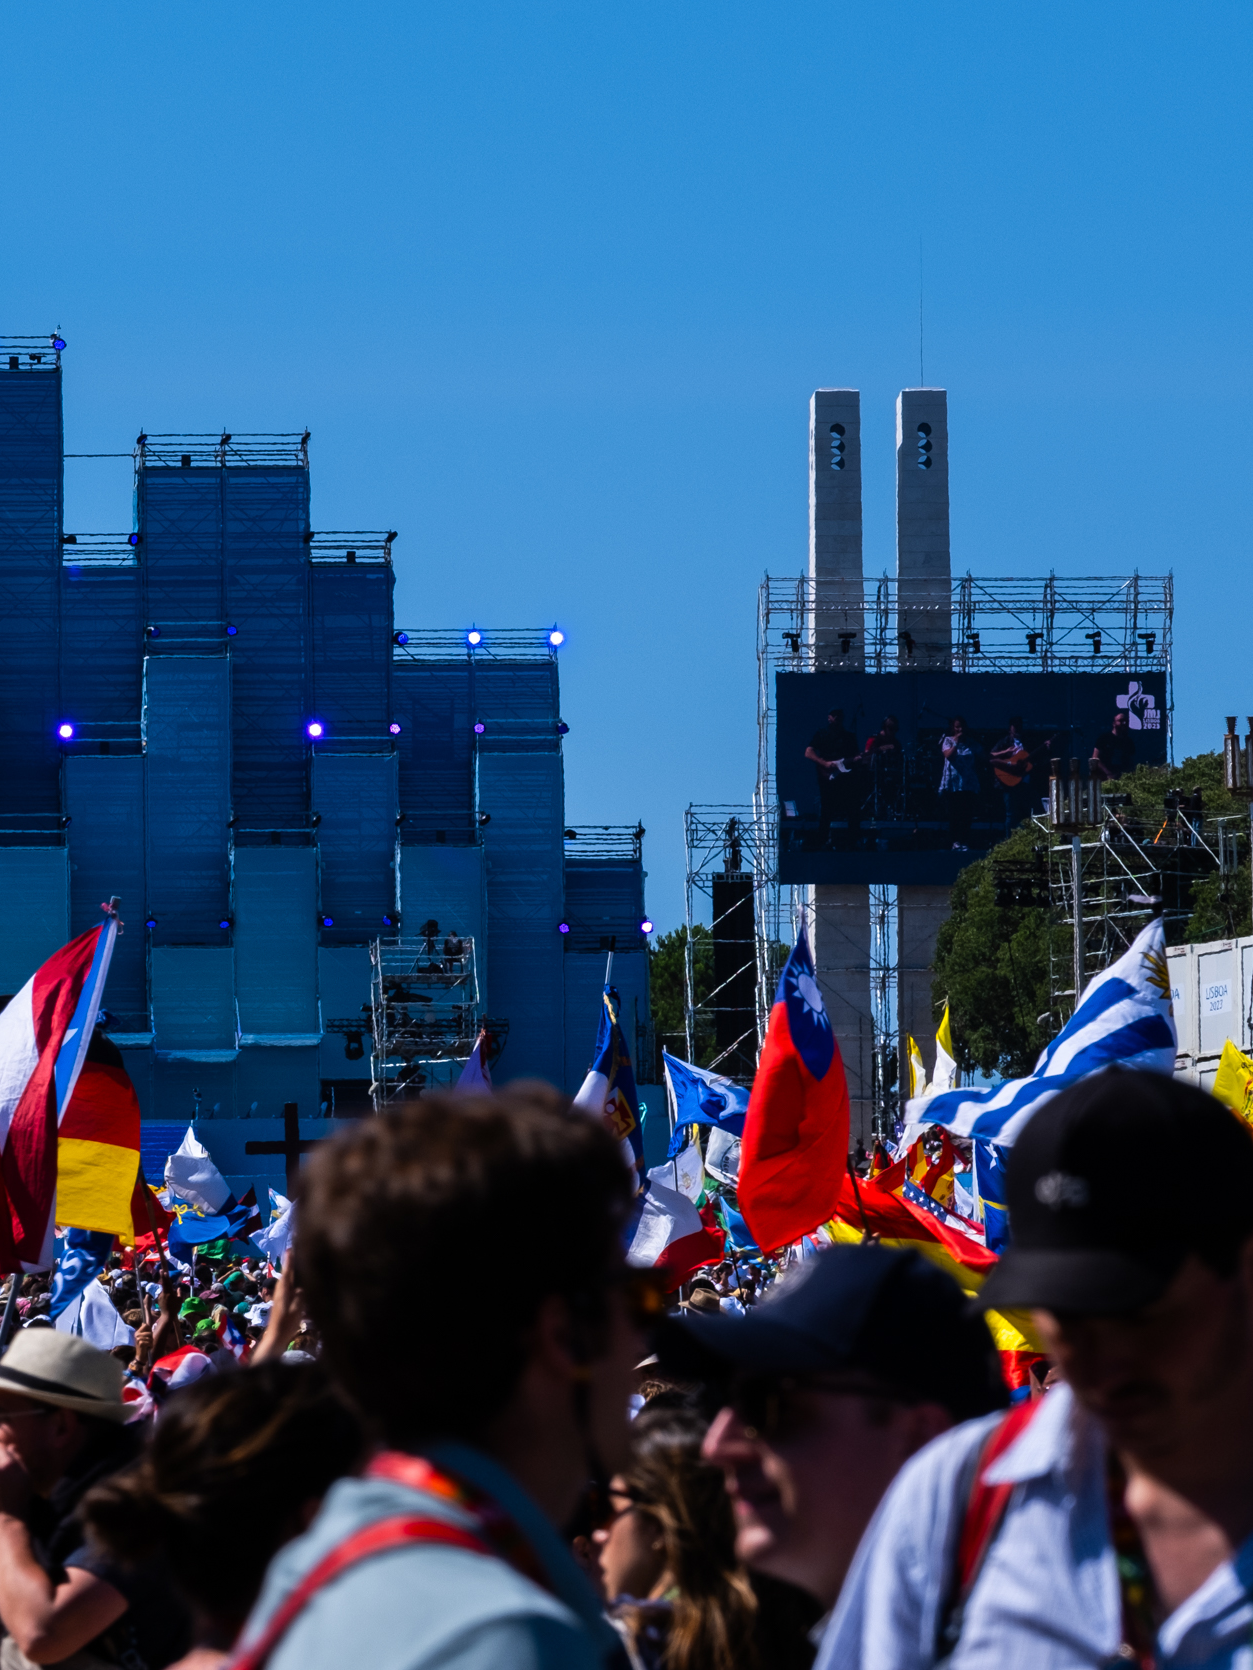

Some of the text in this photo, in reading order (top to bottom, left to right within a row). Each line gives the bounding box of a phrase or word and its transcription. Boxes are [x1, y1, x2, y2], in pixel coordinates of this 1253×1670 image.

[1143, 709, 1160, 719] JMJ
[1205, 984, 1228, 1000] LISBOA
[1209, 999, 1223, 1012] 2023
